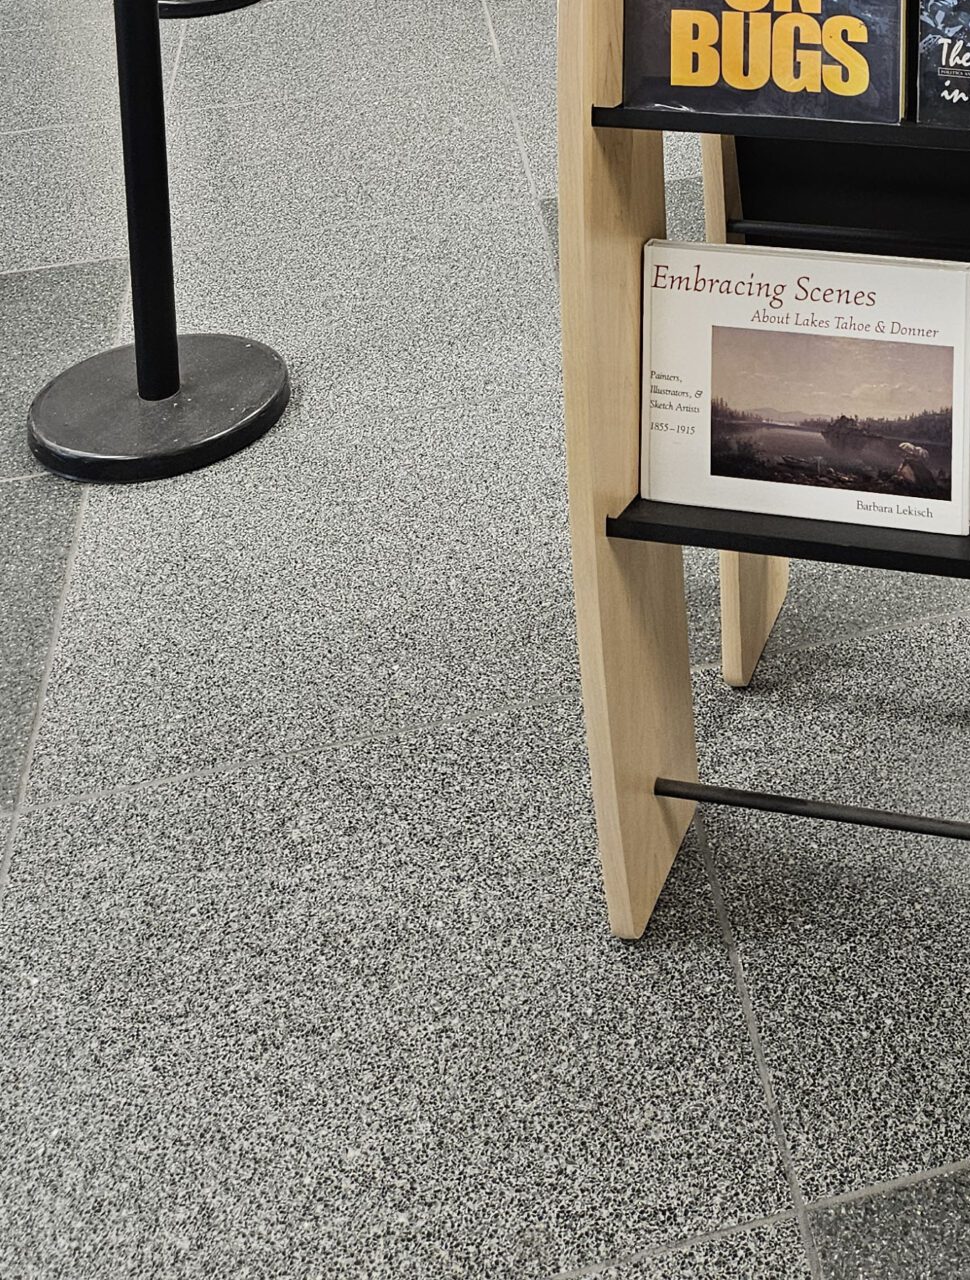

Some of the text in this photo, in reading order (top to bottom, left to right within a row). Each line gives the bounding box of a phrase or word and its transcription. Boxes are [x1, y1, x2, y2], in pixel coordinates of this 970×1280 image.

[670, 9, 870, 97] BUGS
[940, 79, 969, 103] in
[651, 264, 878, 310] Embracing Scenes
[750, 308, 940, 339] About Lakes Tahoe & Donner
[650, 370, 683, 383] Painters,
[650, 384, 692, 399] Illustrators,
[649, 399, 700, 413] Sketch Artists
[650, 421, 696, 435] 1855–1915
[856, 500, 934, 519] Barbara Lekisch
